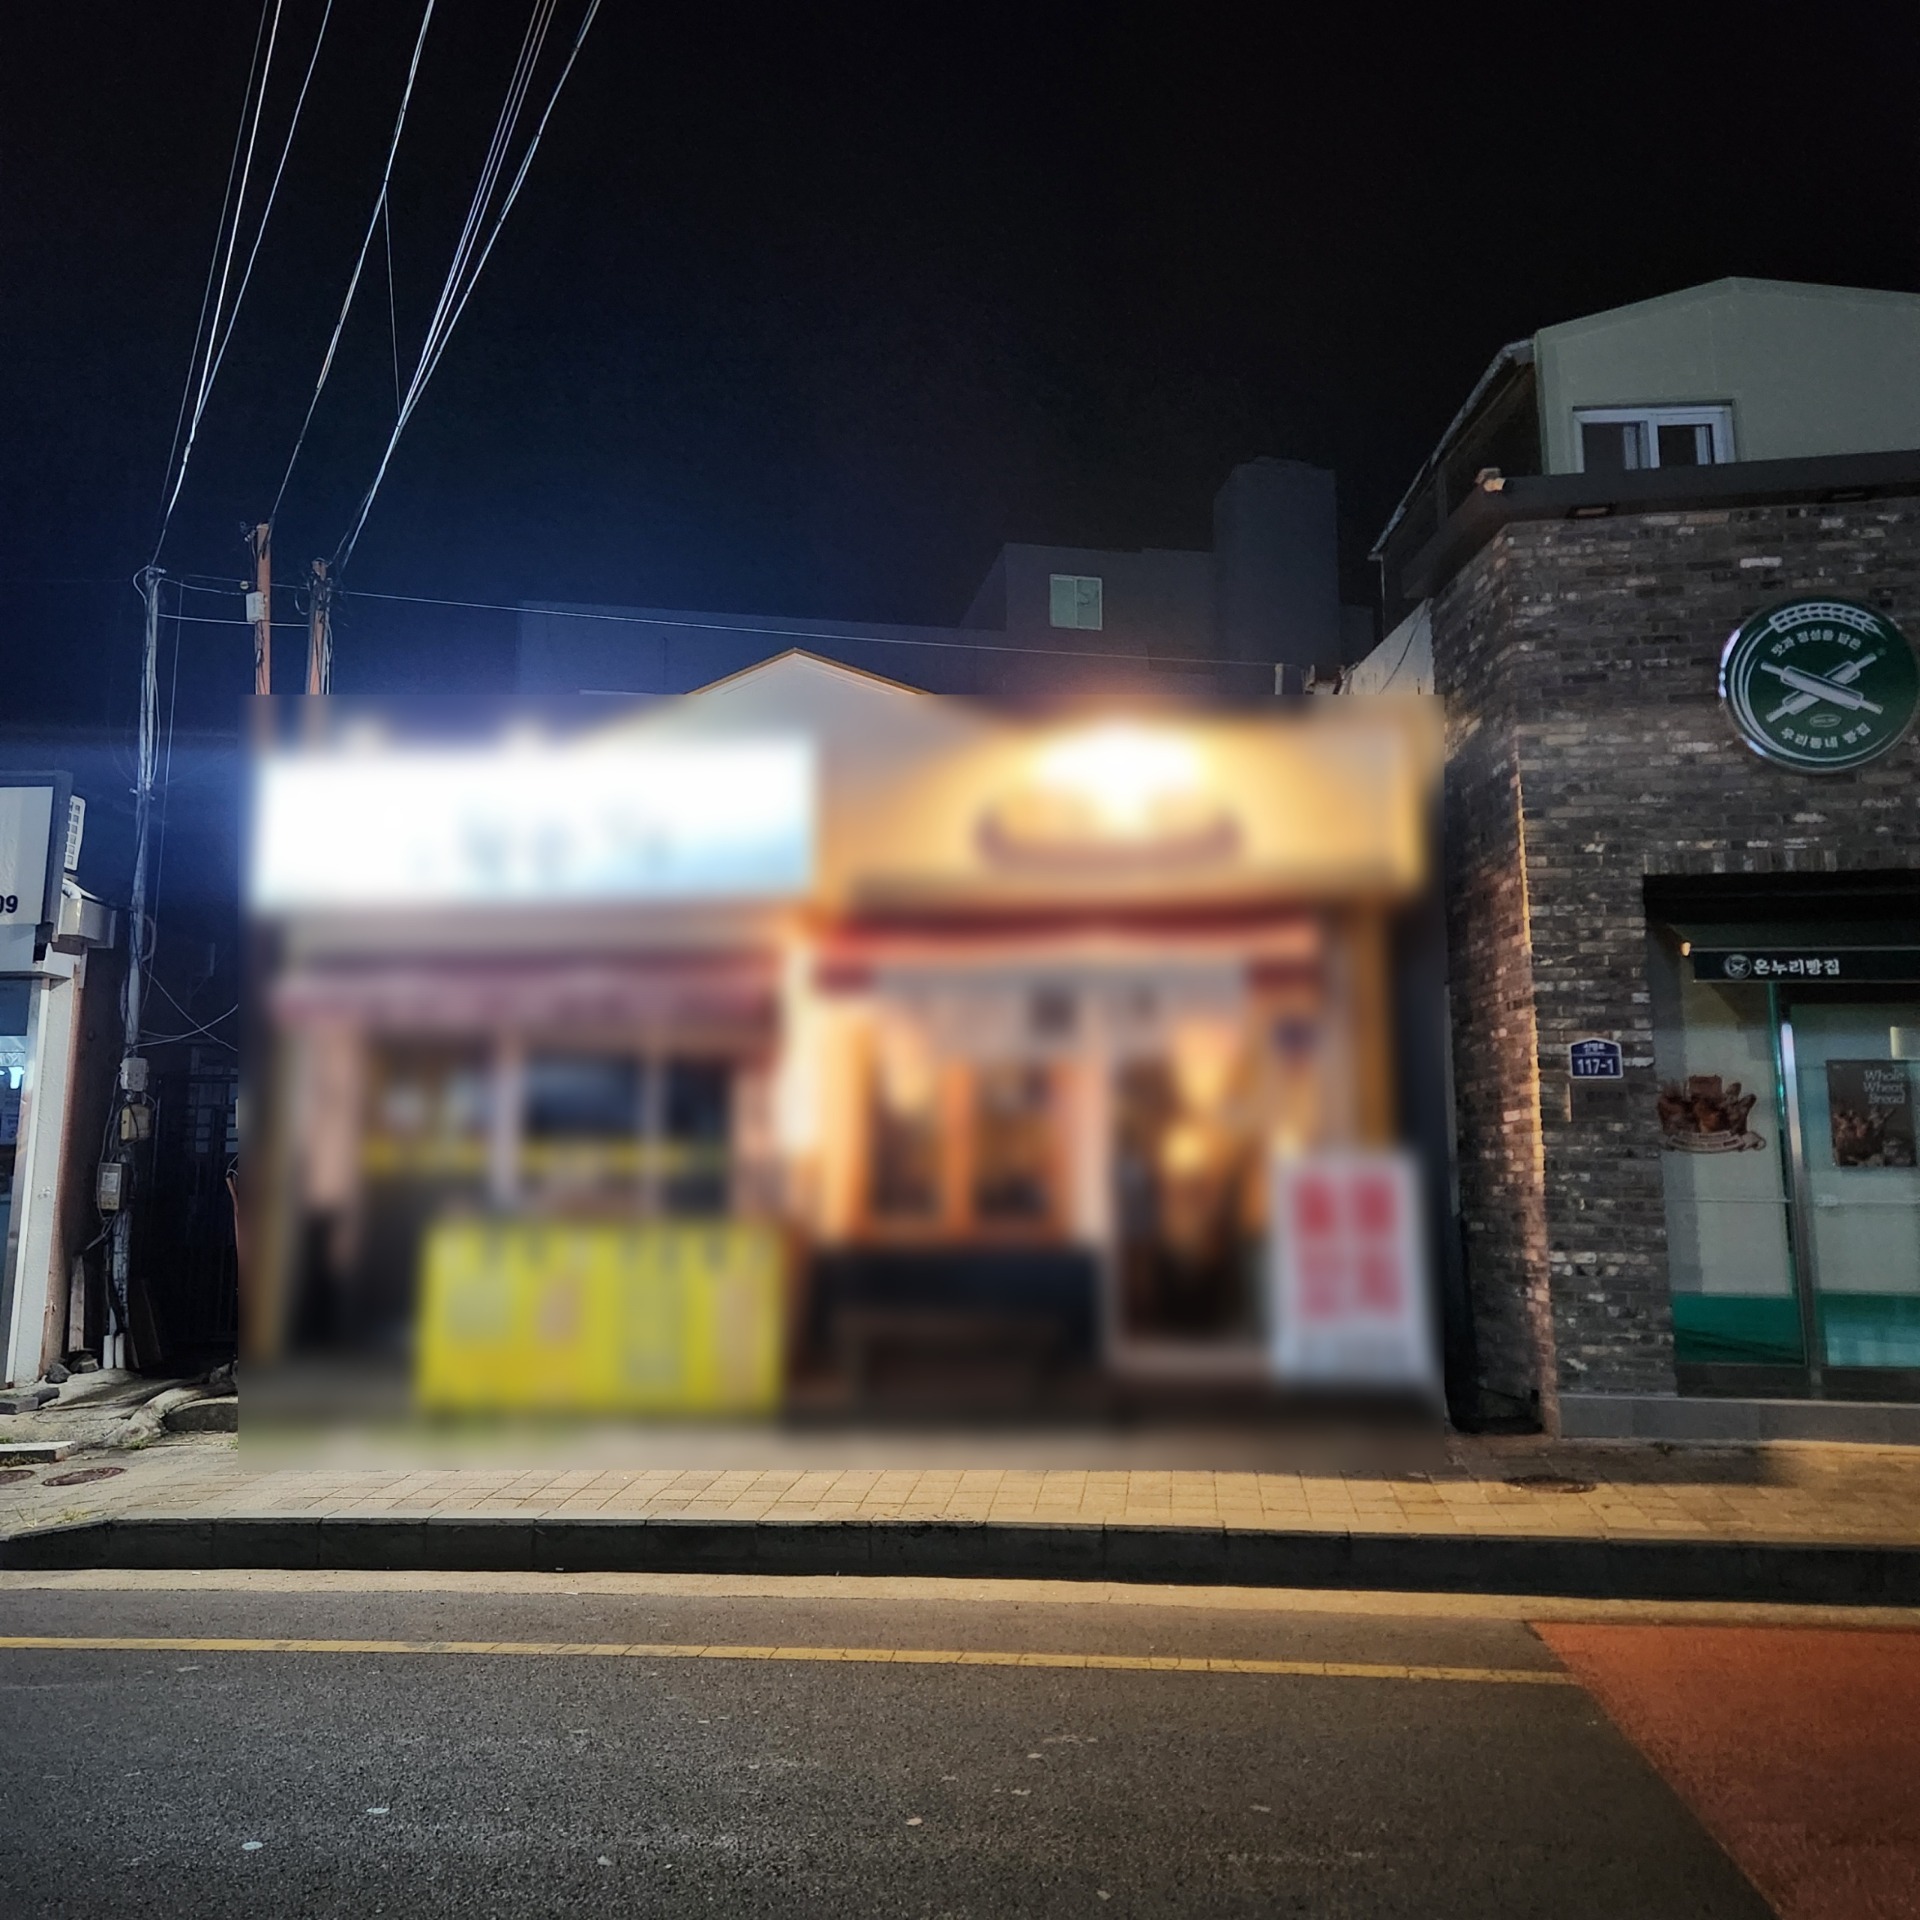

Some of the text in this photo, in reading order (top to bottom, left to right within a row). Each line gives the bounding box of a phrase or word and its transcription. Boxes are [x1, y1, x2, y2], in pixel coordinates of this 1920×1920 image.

[1770, 629, 1862, 657] 맛과 정성을 담은
[1780, 721, 1872, 749] 우리동네 빵집
[1753, 957, 1841, 976] 온누리빵집
[1577, 1058, 1614, 1075] 117-1
[1864, 1067, 1905, 1081] Whole
[1863, 1080, 1905, 1093] Wheat
[1868, 1091, 1906, 1104] Bread
